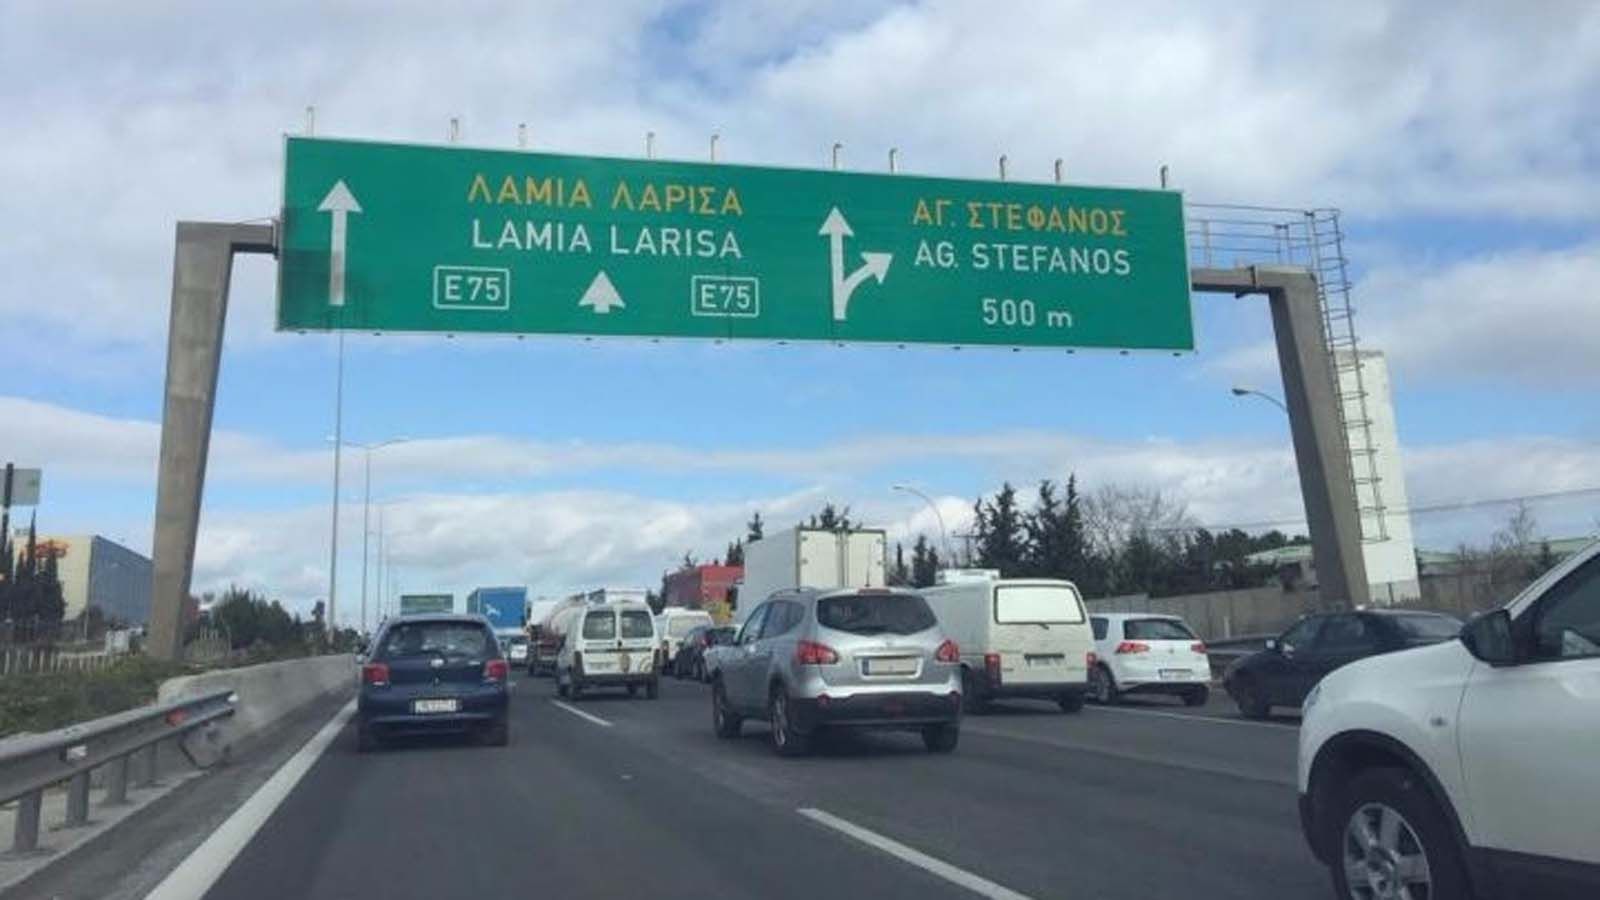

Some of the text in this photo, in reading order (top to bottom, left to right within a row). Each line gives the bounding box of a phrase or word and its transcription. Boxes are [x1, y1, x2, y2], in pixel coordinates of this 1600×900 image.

[469, 174, 743, 215] ΛΑΜΙΑ ΛΑΡΙΣΑ
[913, 199, 1128, 236] ΑΓ. ΣΤΕΦΑΝΟΣ
[472, 219, 742, 259] LAMIA LARISA
[914, 240, 1130, 275] AG. STEFANOS
[444, 276, 501, 302] E75
[701, 284, 750, 309] E75
[983, 298, 1072, 327] 500 m
